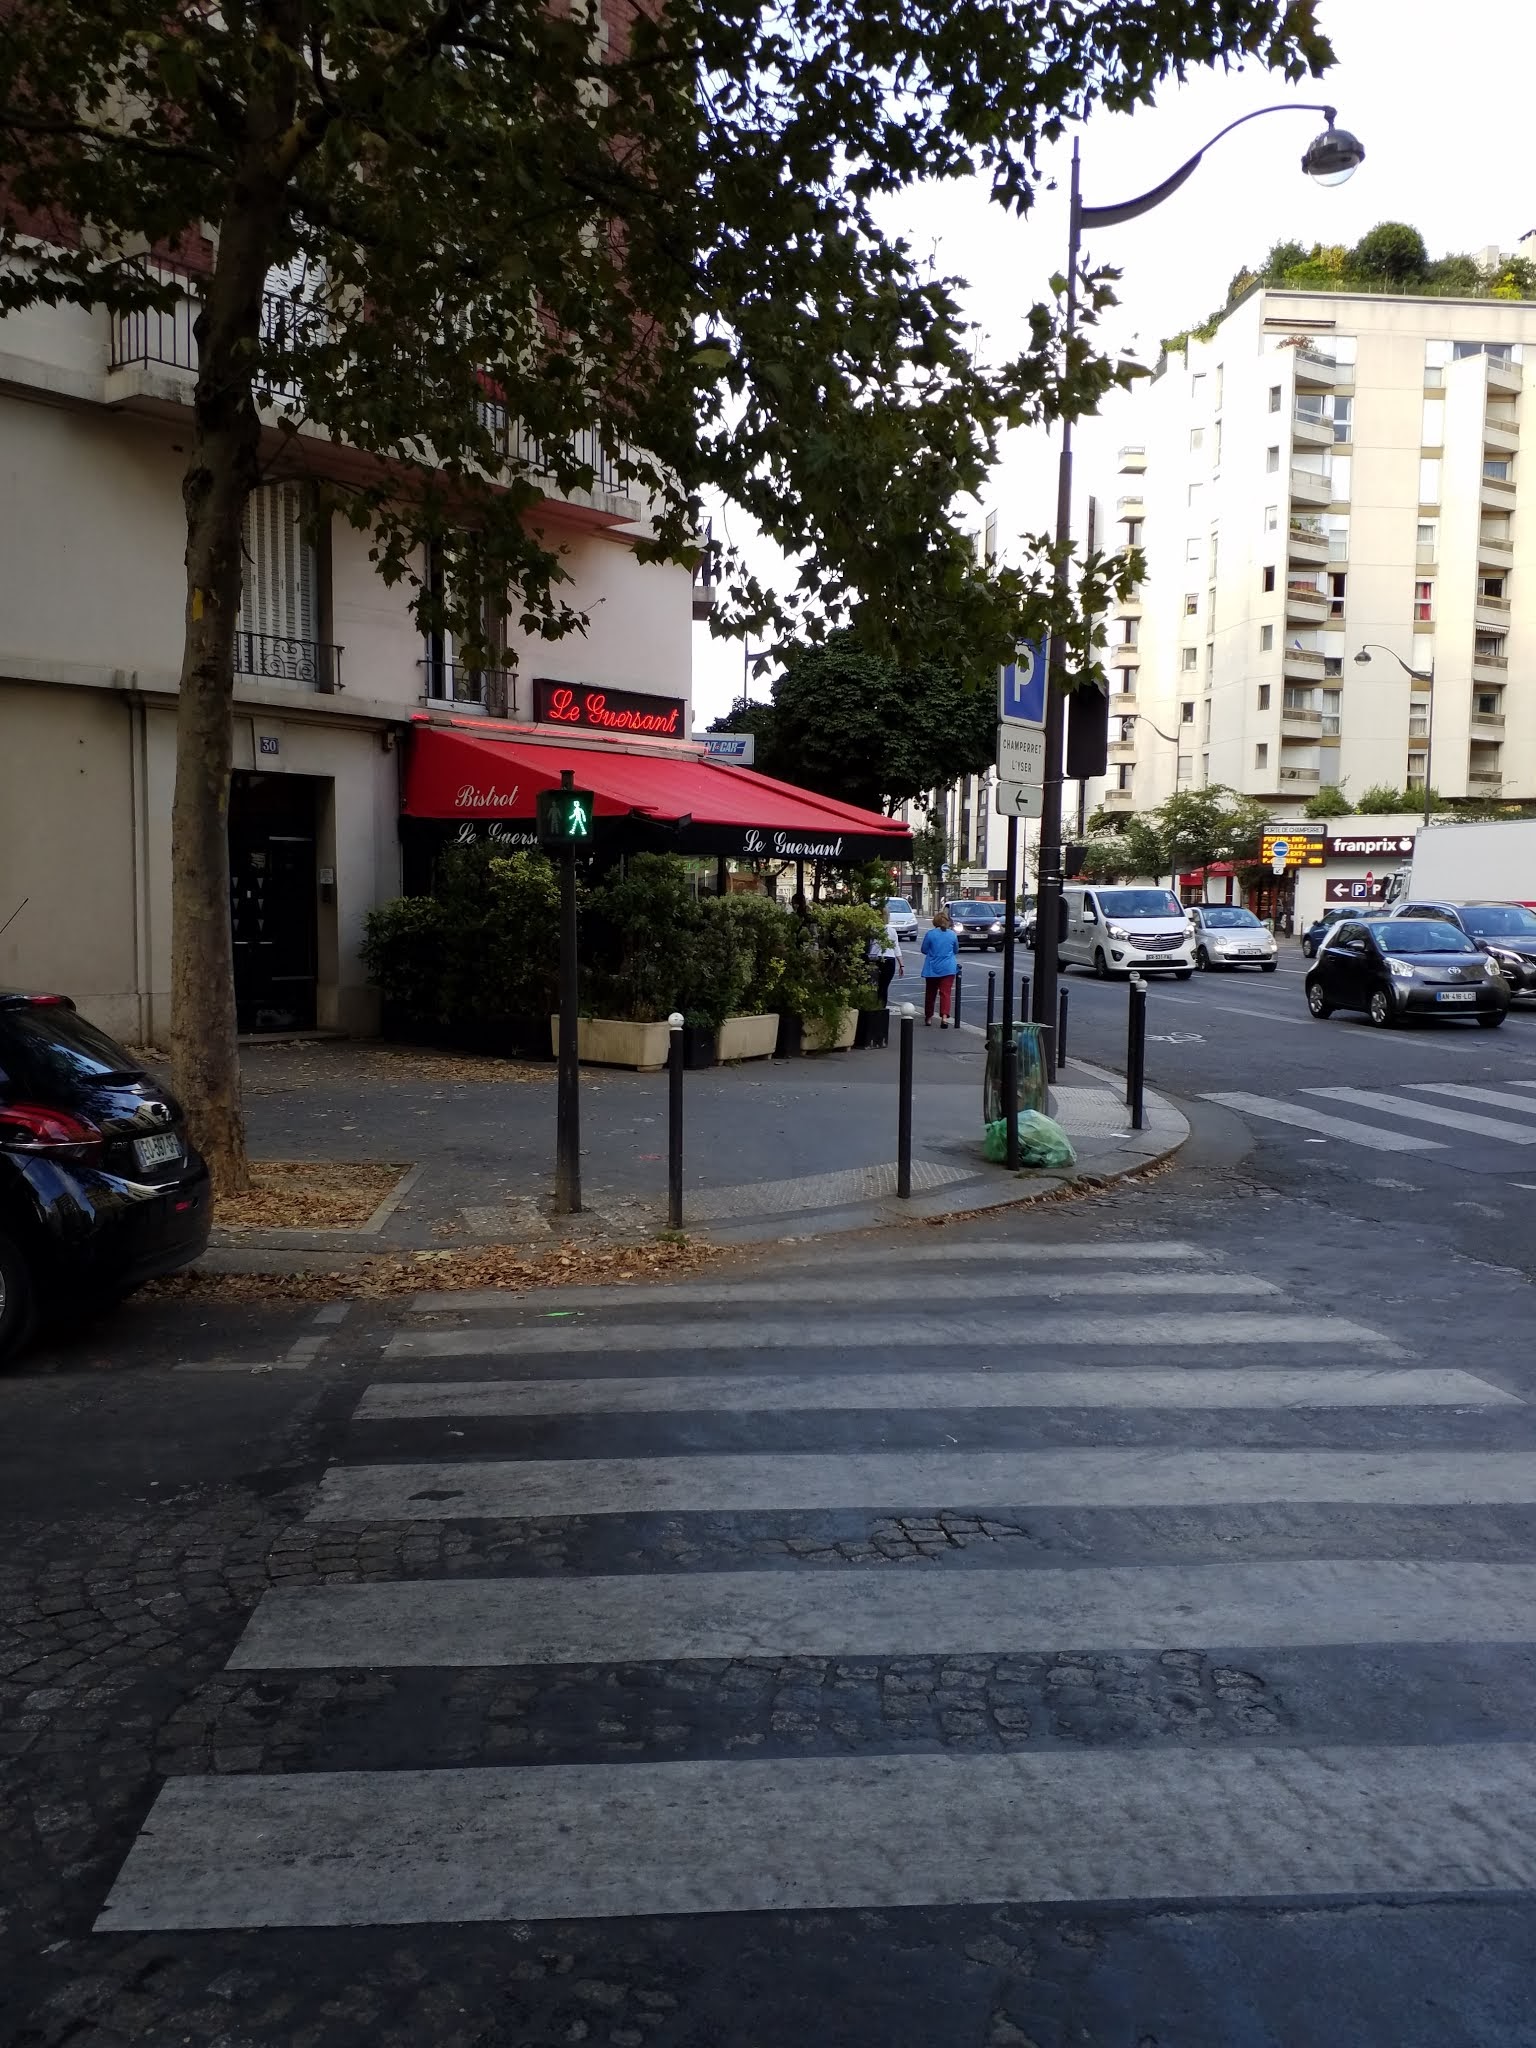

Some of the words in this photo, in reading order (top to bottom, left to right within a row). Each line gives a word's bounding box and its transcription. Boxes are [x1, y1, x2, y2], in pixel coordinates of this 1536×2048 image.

[1014, 641, 1034, 702] P
[549, 689, 580, 721] Le
[587, 693, 680, 733] Guersant
[262, 739, 277, 752] 30
[720, 742, 738, 753] CAR
[1003, 739, 1042, 755] CHAMPERRET
[454, 784, 520, 807] Bistrot
[454, 822, 479, 844] Le
[487, 822, 540, 845] Guers
[743, 830, 767, 853] Le
[773, 831, 844, 856] Guersant
[1333, 838, 1397, 854] franprix
[1354, 885, 1364, 896] P
